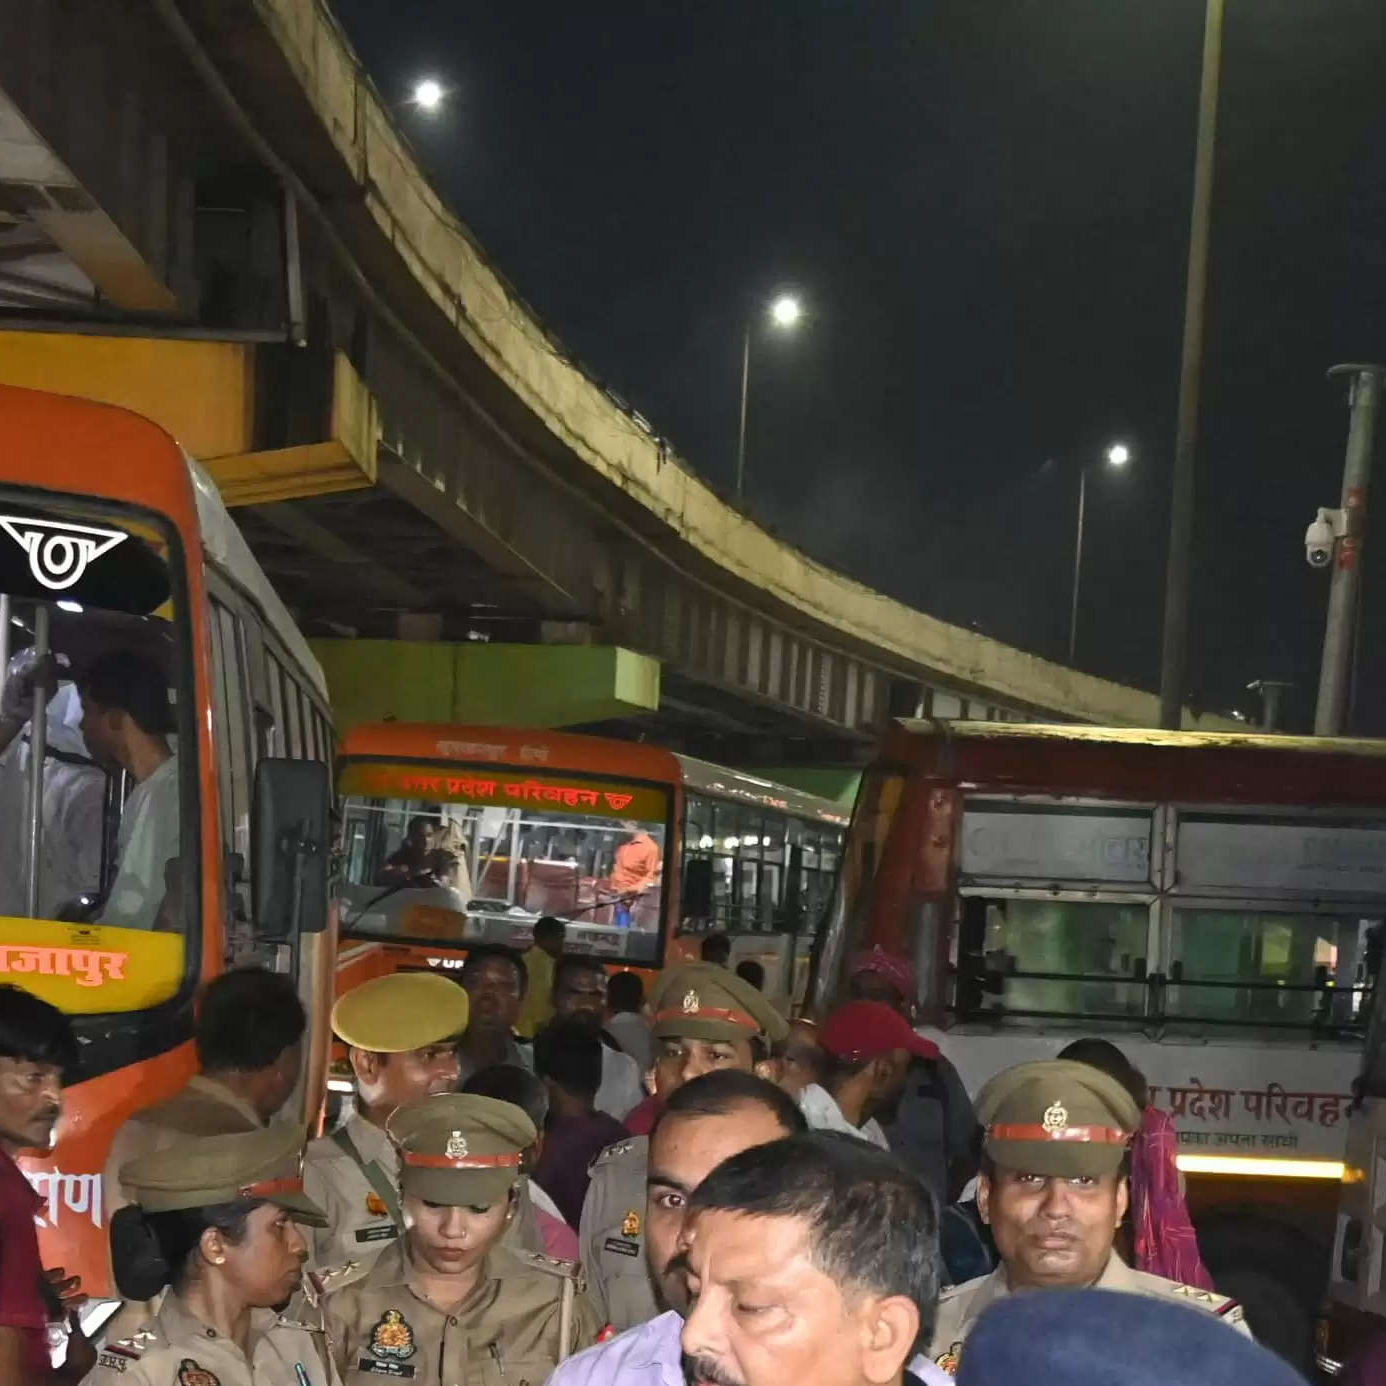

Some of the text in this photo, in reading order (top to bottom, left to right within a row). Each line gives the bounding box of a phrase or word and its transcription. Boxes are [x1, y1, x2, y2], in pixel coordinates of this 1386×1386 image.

[445, 776, 497, 798] प्रदेश
[503, 780, 599, 807] परिवहन
[1168, 1077, 1236, 1121] प्रदेश
[1241, 1082, 1354, 1127] परिवह
